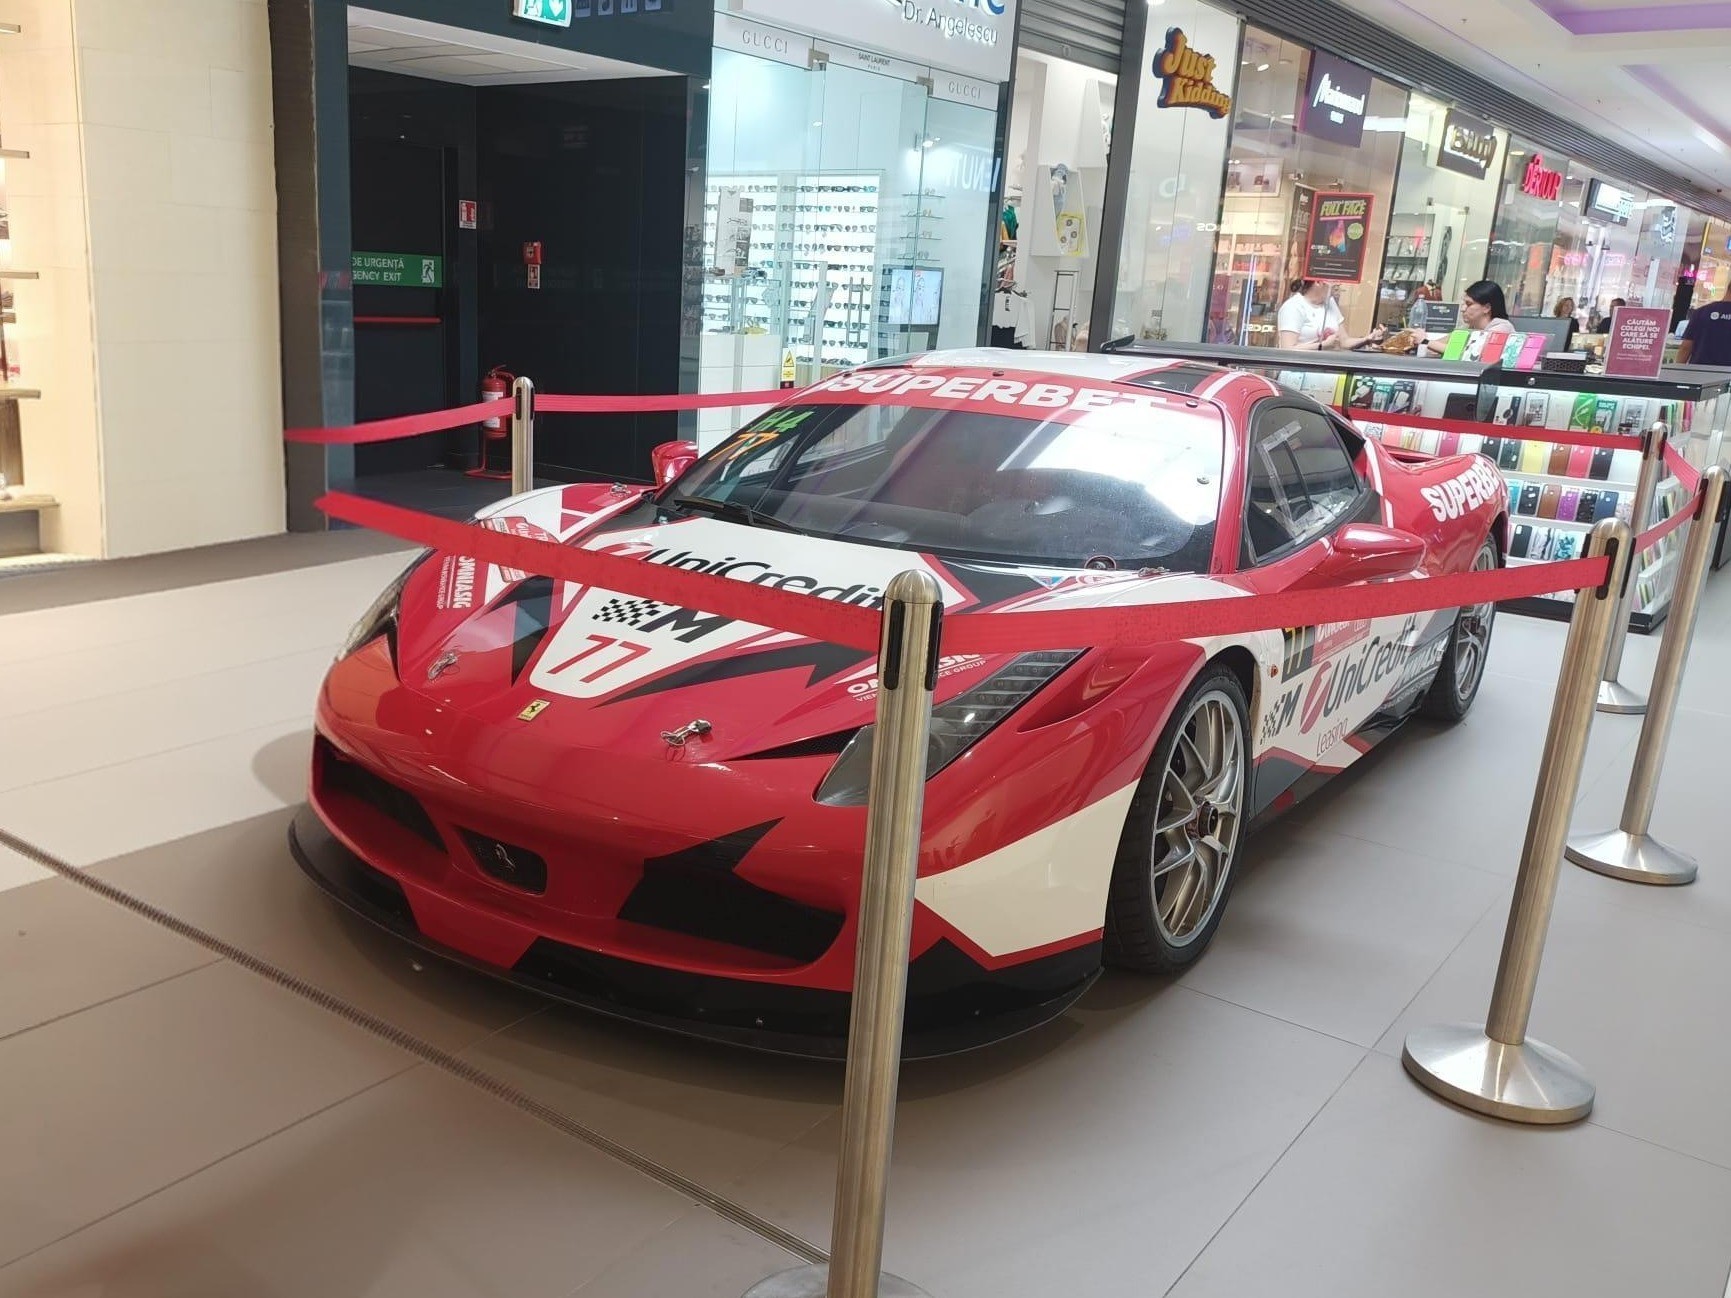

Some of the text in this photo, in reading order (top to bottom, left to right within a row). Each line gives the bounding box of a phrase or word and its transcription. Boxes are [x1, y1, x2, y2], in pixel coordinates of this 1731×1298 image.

[904, 1, 923, 24] Dr.
[927, 7, 998, 44] Angelescu
[742, 30, 788, 54] GUCCI
[1157, 28, 1216, 82] Just
[948, 81, 982, 99] GUCCI
[1320, 200, 1367, 217] FULL FACE
[383, 271, 402, 282] EXIT
[546, 634, 653, 684] 77
